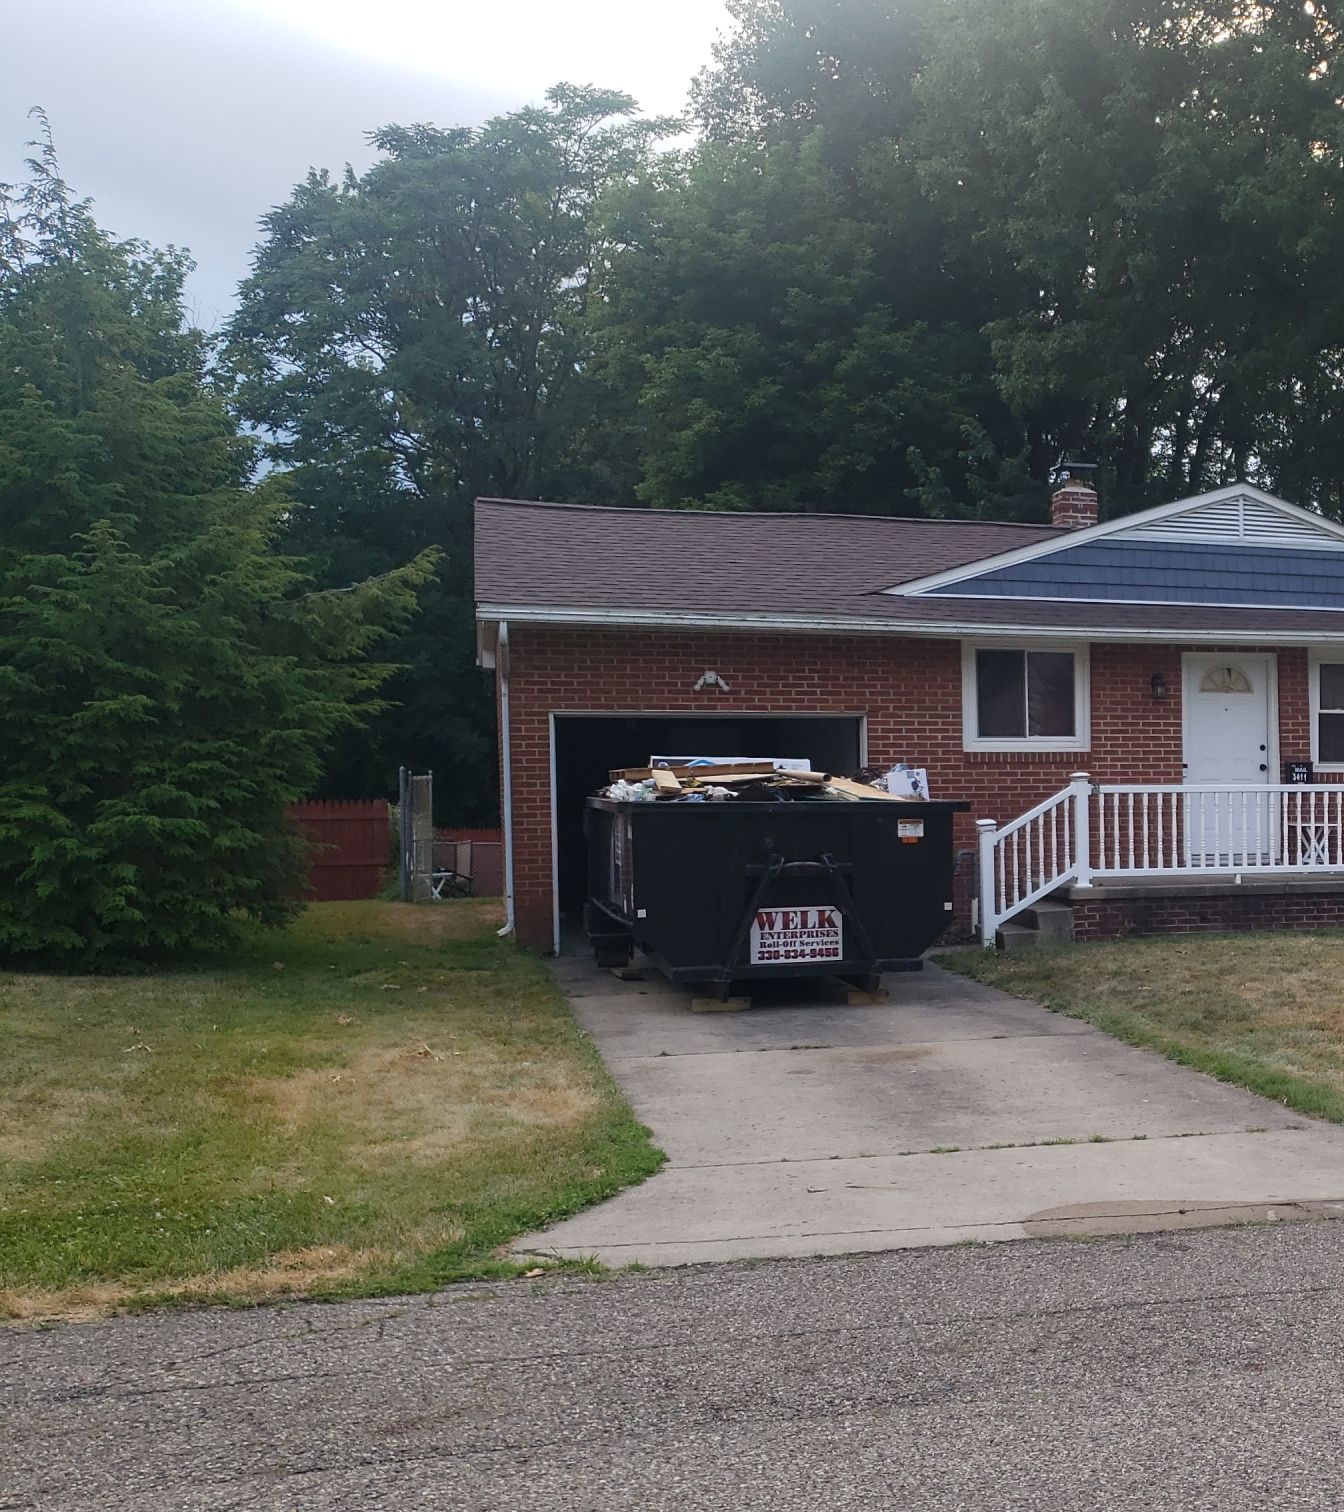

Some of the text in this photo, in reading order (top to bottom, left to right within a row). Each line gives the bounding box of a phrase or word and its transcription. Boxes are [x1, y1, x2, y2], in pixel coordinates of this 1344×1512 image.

[756, 910, 838, 931] WELK
[760, 929, 839, 940] ENTERPRISES
[759, 939, 840, 949] Roll-Off Services
